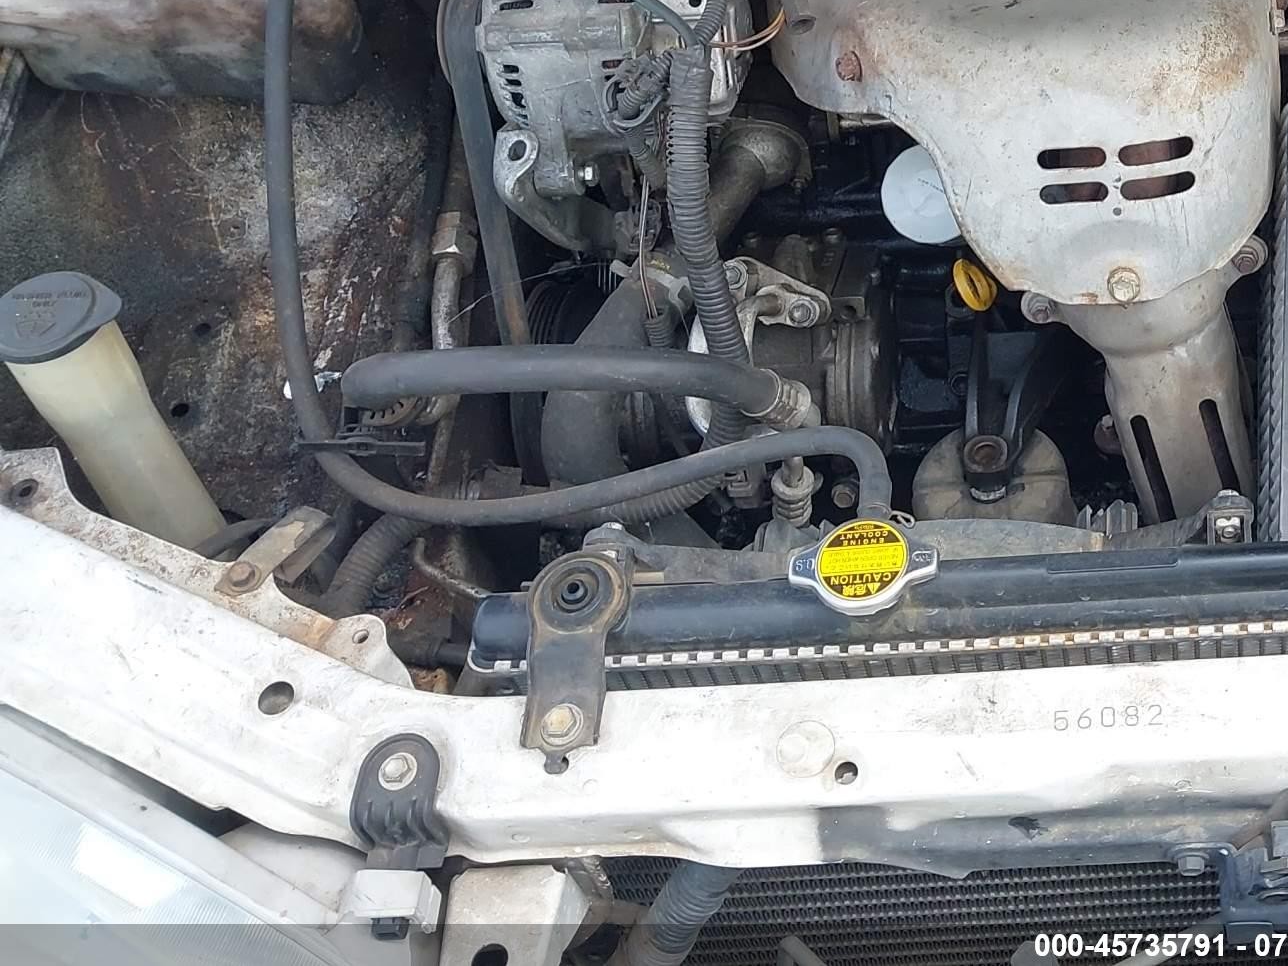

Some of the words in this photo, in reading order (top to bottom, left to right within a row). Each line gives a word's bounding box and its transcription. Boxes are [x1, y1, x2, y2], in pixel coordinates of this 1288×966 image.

[839, 530, 889, 540] COOLANT
[842, 537, 885, 546] ENGINE
[830, 572, 892, 586] CAUTION
[1053, 704, 1163, 731] 56082
